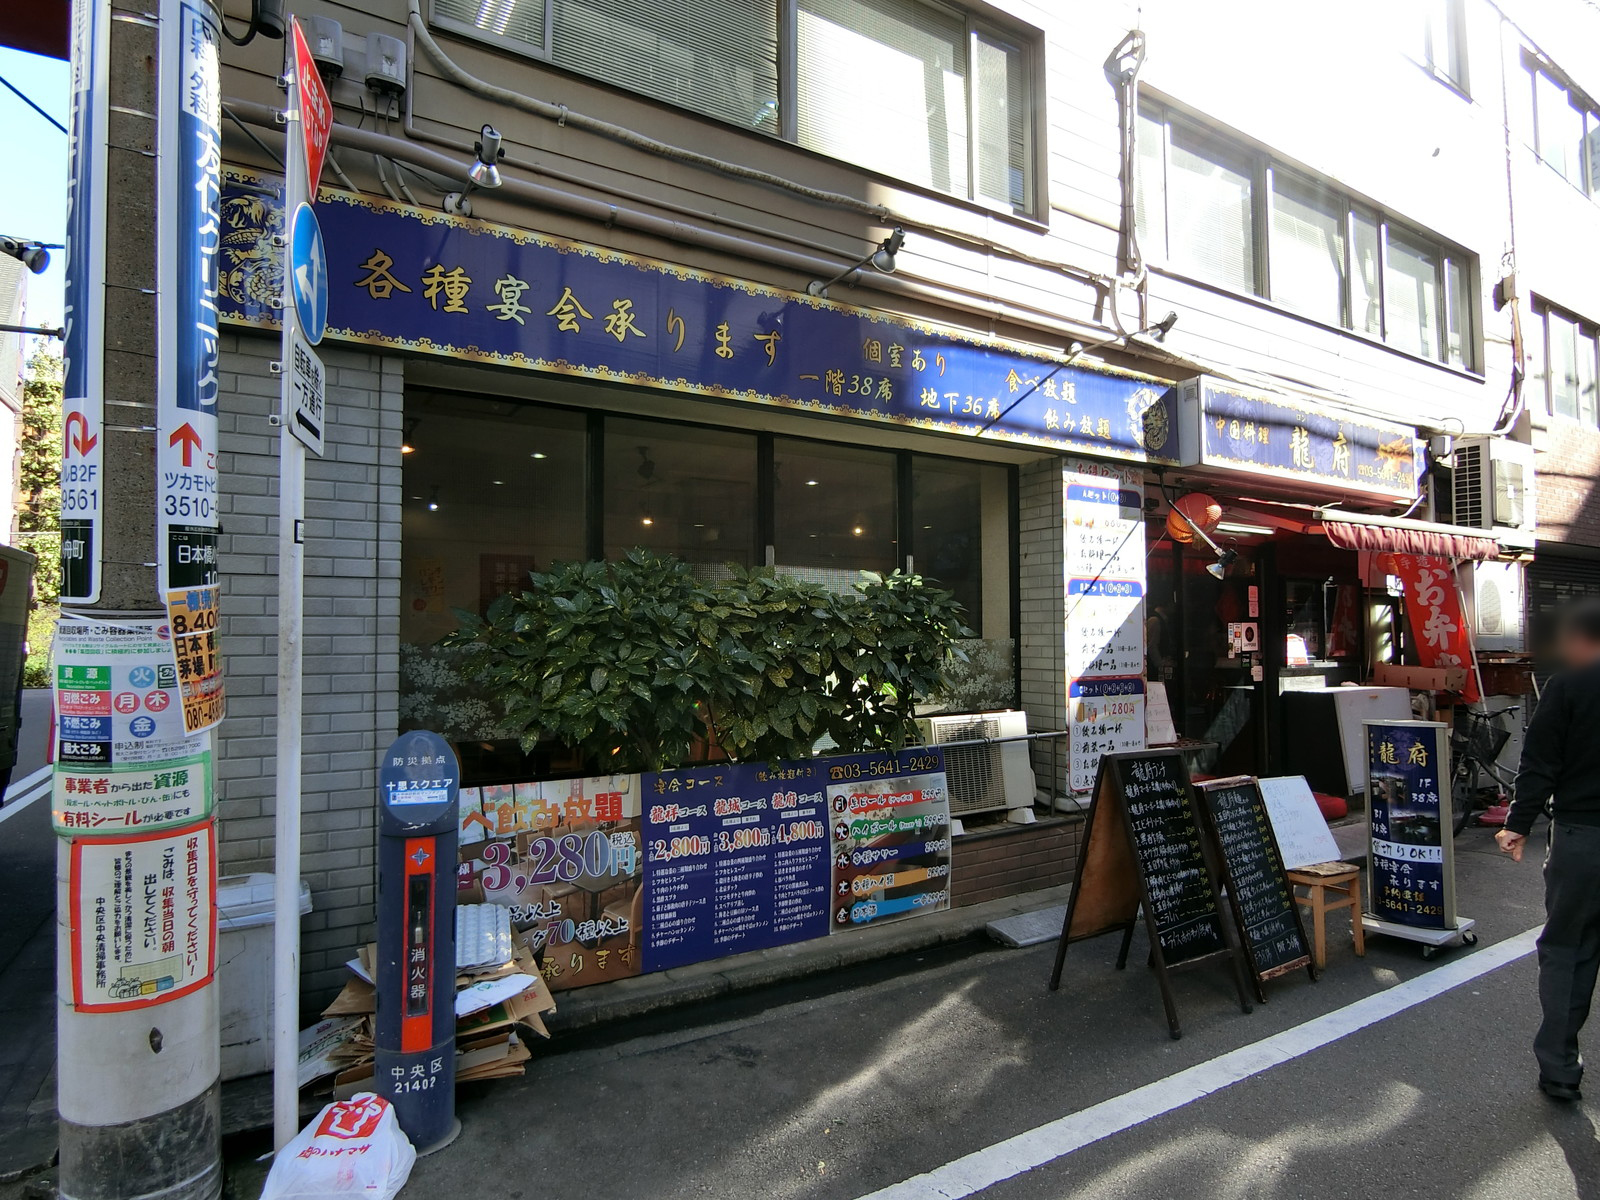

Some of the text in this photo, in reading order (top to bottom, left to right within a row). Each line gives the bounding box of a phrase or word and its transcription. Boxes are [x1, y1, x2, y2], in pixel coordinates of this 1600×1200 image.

[302, 62, 327, 130] 止まれ
[306, 104, 323, 153] STOP
[354, 248, 783, 368] 各種宴会承ります
[862, 337, 946, 377] 個室あり
[799, 368, 893, 404] 一階38席
[1004, 368, 1077, 405] 食べ放題
[295, 381, 322, 421] 一方通行
[1043, 407, 1112, 440] 飲み放題
[1215, 415, 1270, 445] 中国料理
[1289, 426, 1350, 477] 龍府
[65, 667, 98, 679] 資源
[134, 671, 150, 683] 火
[64, 693, 101, 705] 可燃ごみ
[118, 694, 135, 708] 月
[148, 692, 166, 707] 木
[64, 717, 101, 729] 不燃ごみ
[133, 717, 152, 732] 金
[64, 742, 101, 755] 粗大ごみ
[115, 741, 145, 751] 申込制
[1378, 741, 1429, 768] 龍府
[392, 755, 446, 767] 防災拠点
[844, 754, 940, 779] 03-5641-2429
[65, 769, 189, 794] 事業者から出た資源
[386, 778, 453, 791] 十思スクエア
[654, 776, 724, 795] 宴会コース
[1418, 778, 1432, 788] 1F
[772, 791, 823, 810] 龍府コース
[834, 796, 845, 811] 月
[1411, 791, 1438, 805] 38席
[64, 807, 191, 828] 有料シールが必要です
[611, 832, 635, 847] 税込
[719, 827, 770, 854] 3,800円
[777, 820, 824, 845] 4,800円
[836, 824, 848, 840] 火
[655, 835, 711, 862] 2,800円
[837, 854, 849, 869] 水
[1374, 857, 1413, 875] 各種宴会
[838, 880, 850, 895] 木
[836, 907, 849, 921] 金
[410, 947, 426, 999] 消火器
[391, 1057, 443, 1080] 中央区
[394, 1077, 436, 1094] 21402
